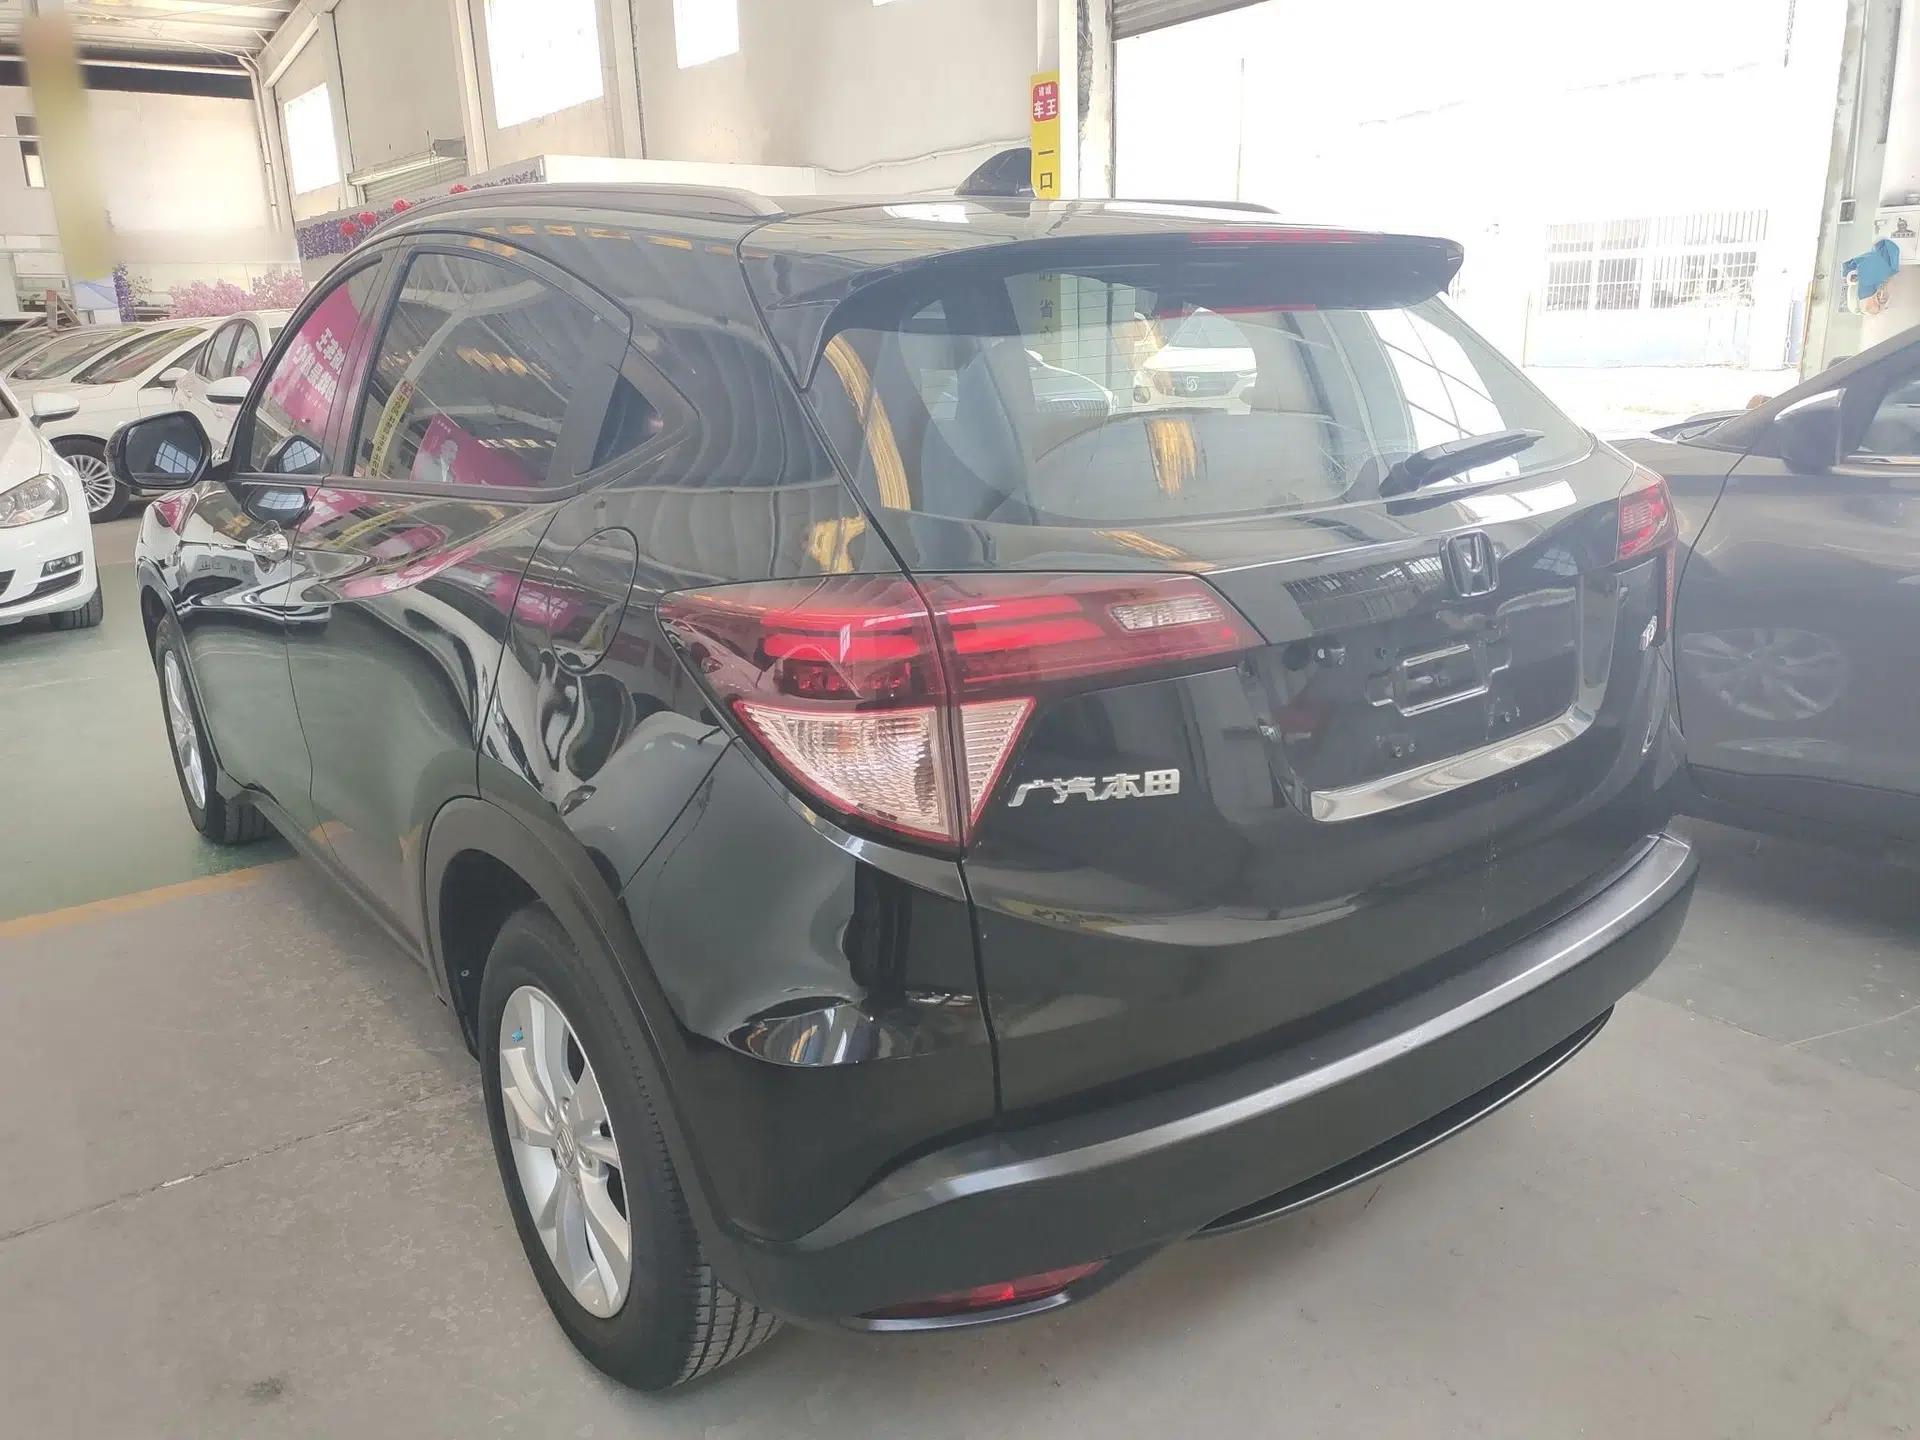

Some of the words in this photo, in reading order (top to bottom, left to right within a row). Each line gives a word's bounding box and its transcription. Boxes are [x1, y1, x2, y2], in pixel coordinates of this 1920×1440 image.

[1034, 98, 1057, 119] 车王
[1038, 149, 1055, 190] 一口
[1008, 768, 1180, 807] 广汽本田
